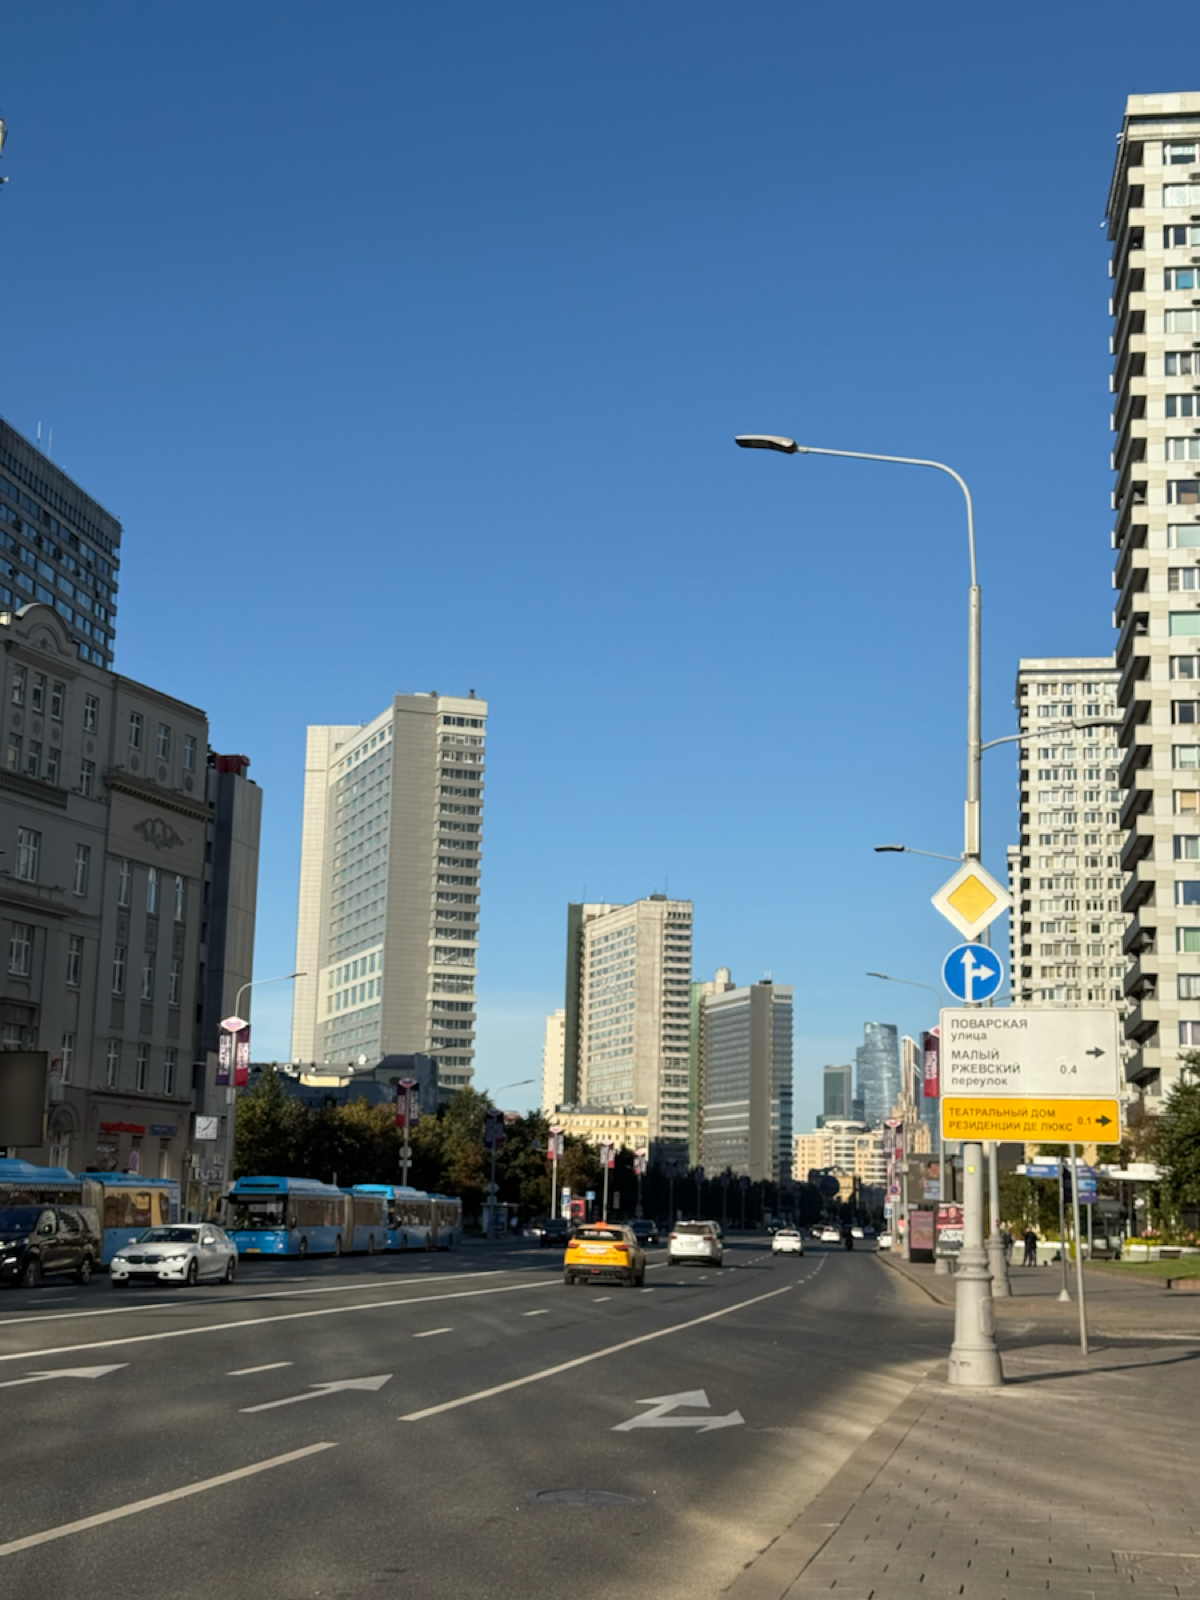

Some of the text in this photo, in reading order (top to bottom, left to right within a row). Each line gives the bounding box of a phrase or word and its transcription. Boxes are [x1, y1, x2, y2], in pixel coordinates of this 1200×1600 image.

[951, 1019, 1028, 1029] ПОВАРСКАЯ
[951, 1032, 987, 1042] улица
[951, 1049, 1000, 1060] МАЛЫЙ
[951, 1062, 1021, 1074] РЖЕВСКИЙ
[1059, 1064, 1078, 1075] 0.4
[951, 1076, 1008, 1087] переулок
[949, 1107, 1056, 1118] ТЕАТРАЛЬНЫЙ ДОМ
[949, 1121, 1073, 1132] РЕЗИДЕНЦИИ ДЕ ЛЮКС
[1077, 1117, 1092, 1125] 0.1
